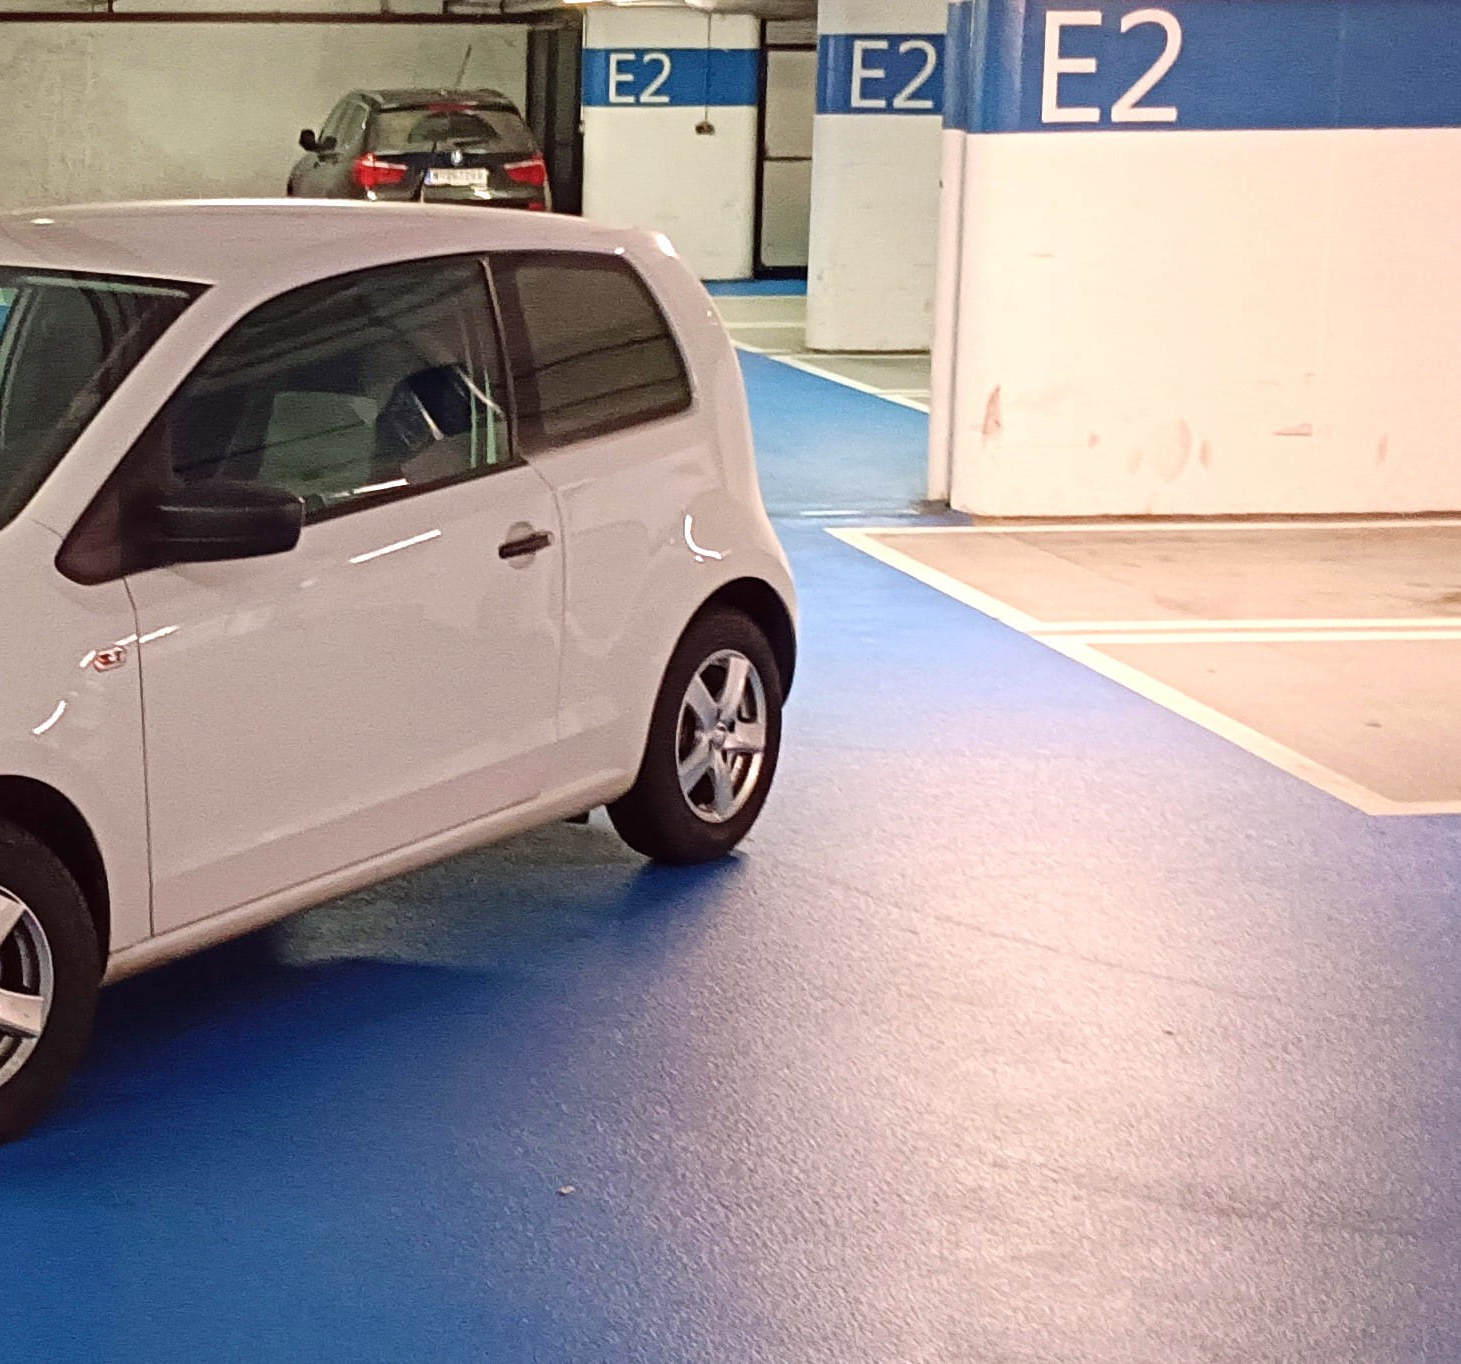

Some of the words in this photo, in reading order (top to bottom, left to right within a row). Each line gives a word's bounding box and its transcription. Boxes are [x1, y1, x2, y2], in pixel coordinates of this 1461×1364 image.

[608, 53, 671, 103] E2
[850, 40, 937, 109] E2
[1041, 9, 1182, 123] E2
